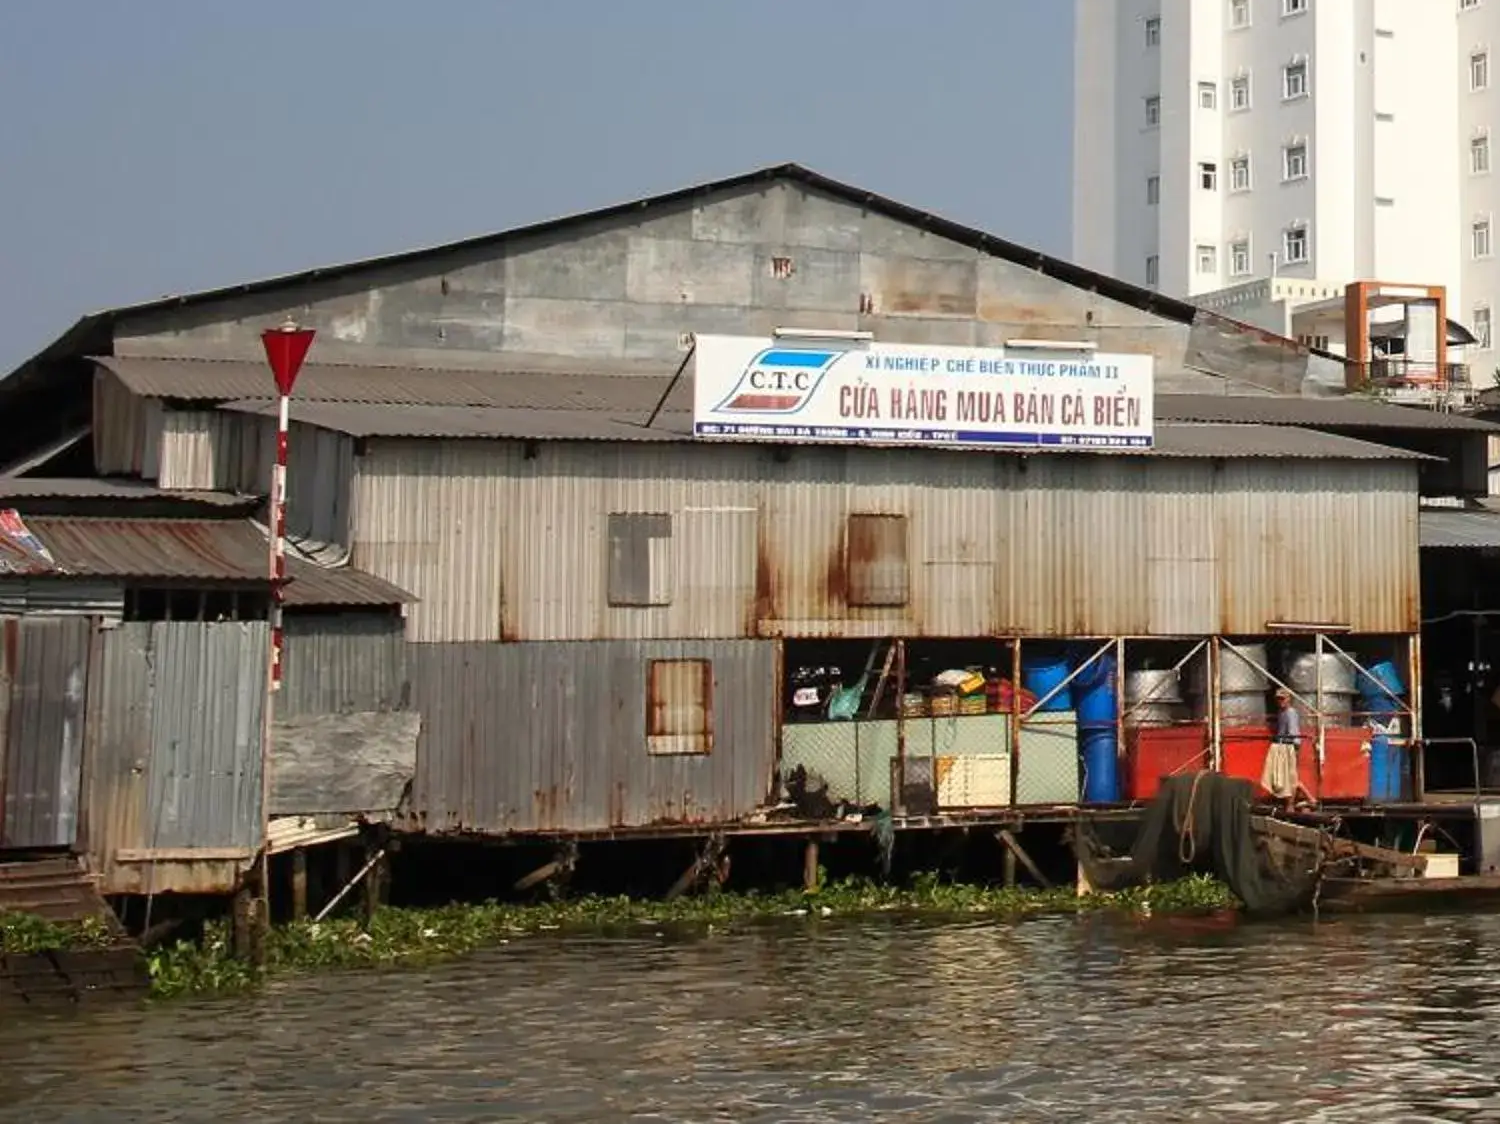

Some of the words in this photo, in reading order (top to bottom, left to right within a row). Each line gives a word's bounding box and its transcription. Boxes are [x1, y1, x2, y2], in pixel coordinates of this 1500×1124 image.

[750, 370, 810, 390] C.T.C
[1105, 365, 1119, 379] II
[839, 378, 880, 419] CỬA
[890, 382, 947, 421] HÀNG
[957, 390, 1006, 423] MUA
[1013, 387, 1055, 425] BÁN
[1061, 388, 1086, 426] CÁ
[1093, 383, 1141, 427] BIỂN
